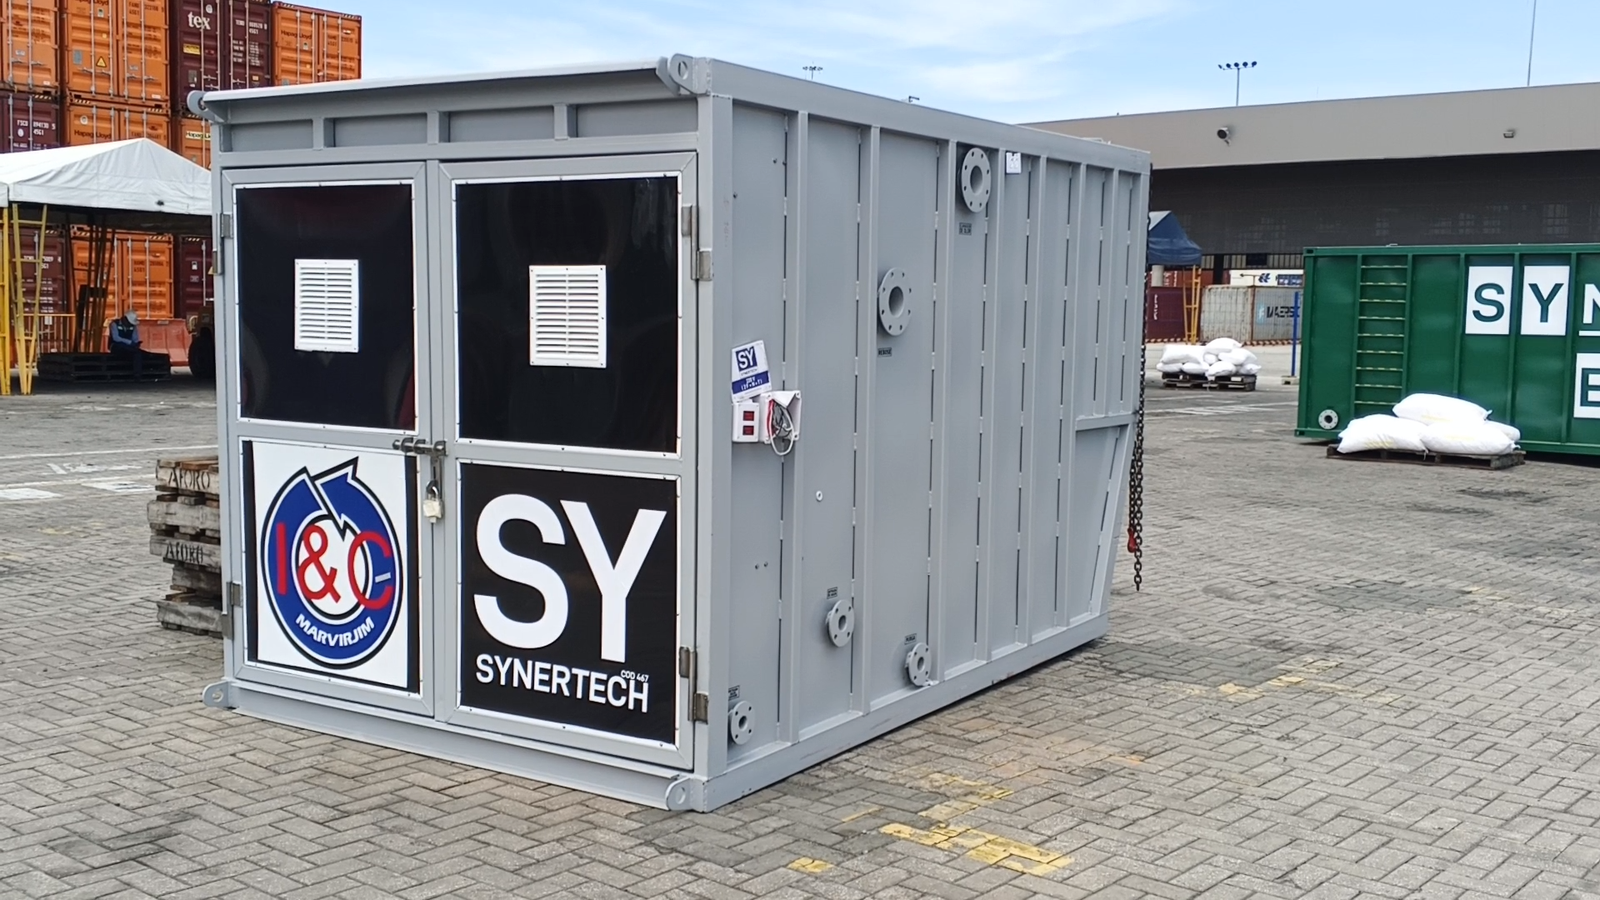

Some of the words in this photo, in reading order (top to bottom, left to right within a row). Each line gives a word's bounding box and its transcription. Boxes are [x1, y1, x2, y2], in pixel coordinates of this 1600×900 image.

[187, 11, 211, 30] tex
[280, 29, 312, 40] HapagLloyd
[73, 128, 112, 140] HapagLloyd
[738, 348, 754, 369] SY
[167, 466, 211, 491] AFORO
[473, 493, 668, 664] SY
[295, 614, 375, 648] MARVIRJIM
[475, 653, 650, 714] SYNERTECH
[620, 669, 636, 681] COD
[636, 674, 650, 683] 467
